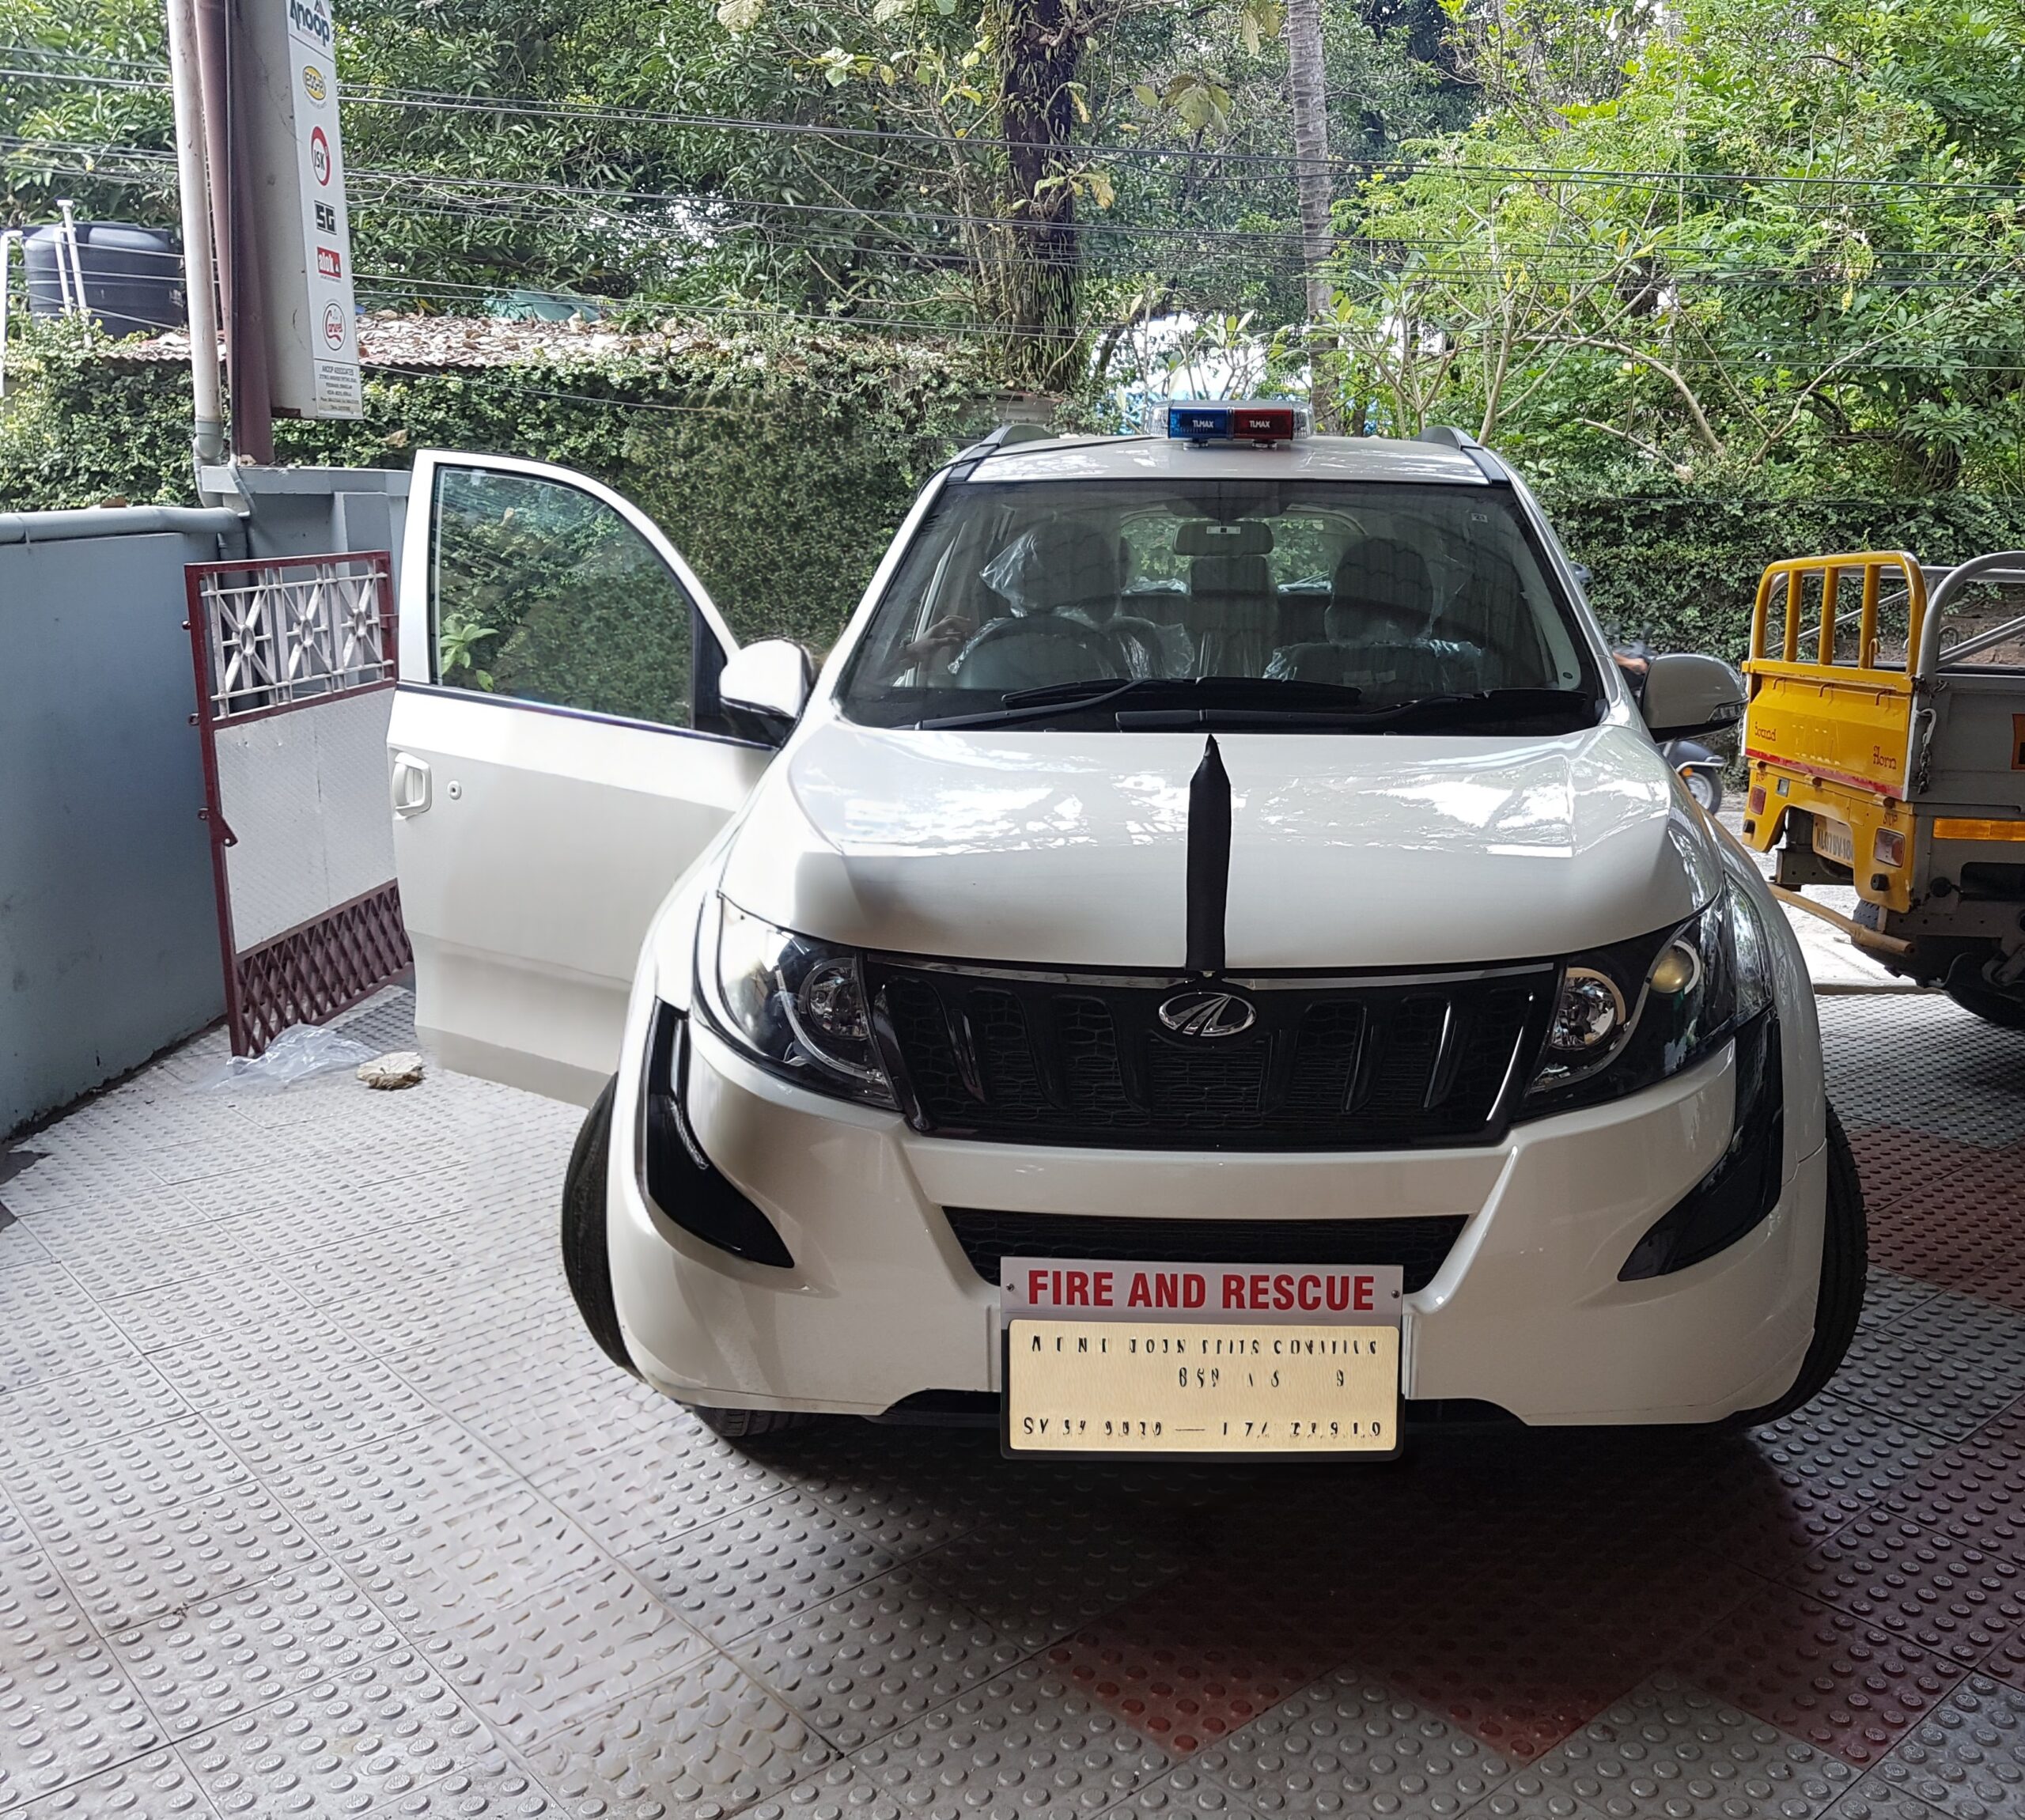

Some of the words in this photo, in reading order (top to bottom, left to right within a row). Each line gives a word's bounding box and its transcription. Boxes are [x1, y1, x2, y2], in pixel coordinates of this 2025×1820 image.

[315, 203, 335, 233] SG
[1872, 745, 1897, 770] Horn
[1028, 1269, 1114, 1307] FIRE
[1127, 1272, 1206, 1309] AND
[1221, 1273, 1375, 1311] RESCUE
